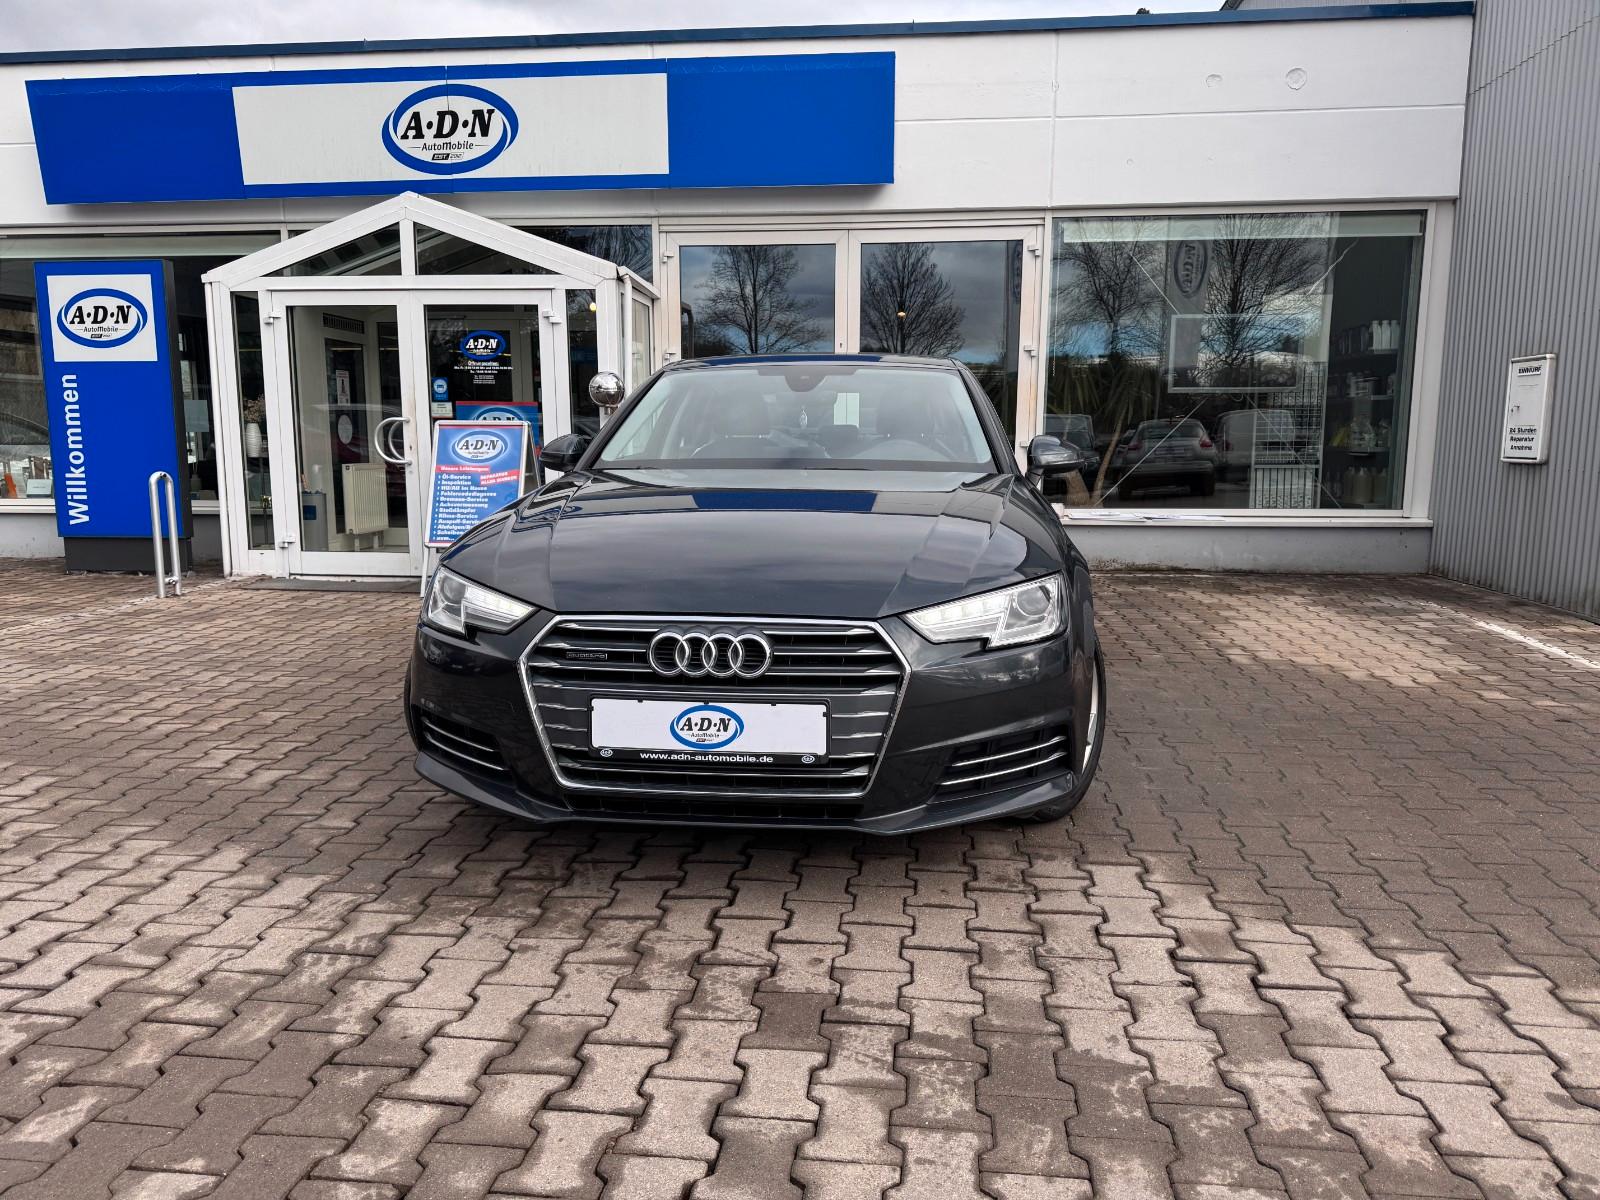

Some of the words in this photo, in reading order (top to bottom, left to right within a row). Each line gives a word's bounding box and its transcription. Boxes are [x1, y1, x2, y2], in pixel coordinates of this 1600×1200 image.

[421, 141, 474, 151] AutoMobile
[61, 374, 90, 526] Willkommen
[640, 752, 774, 763] www.adn-automobile.de
